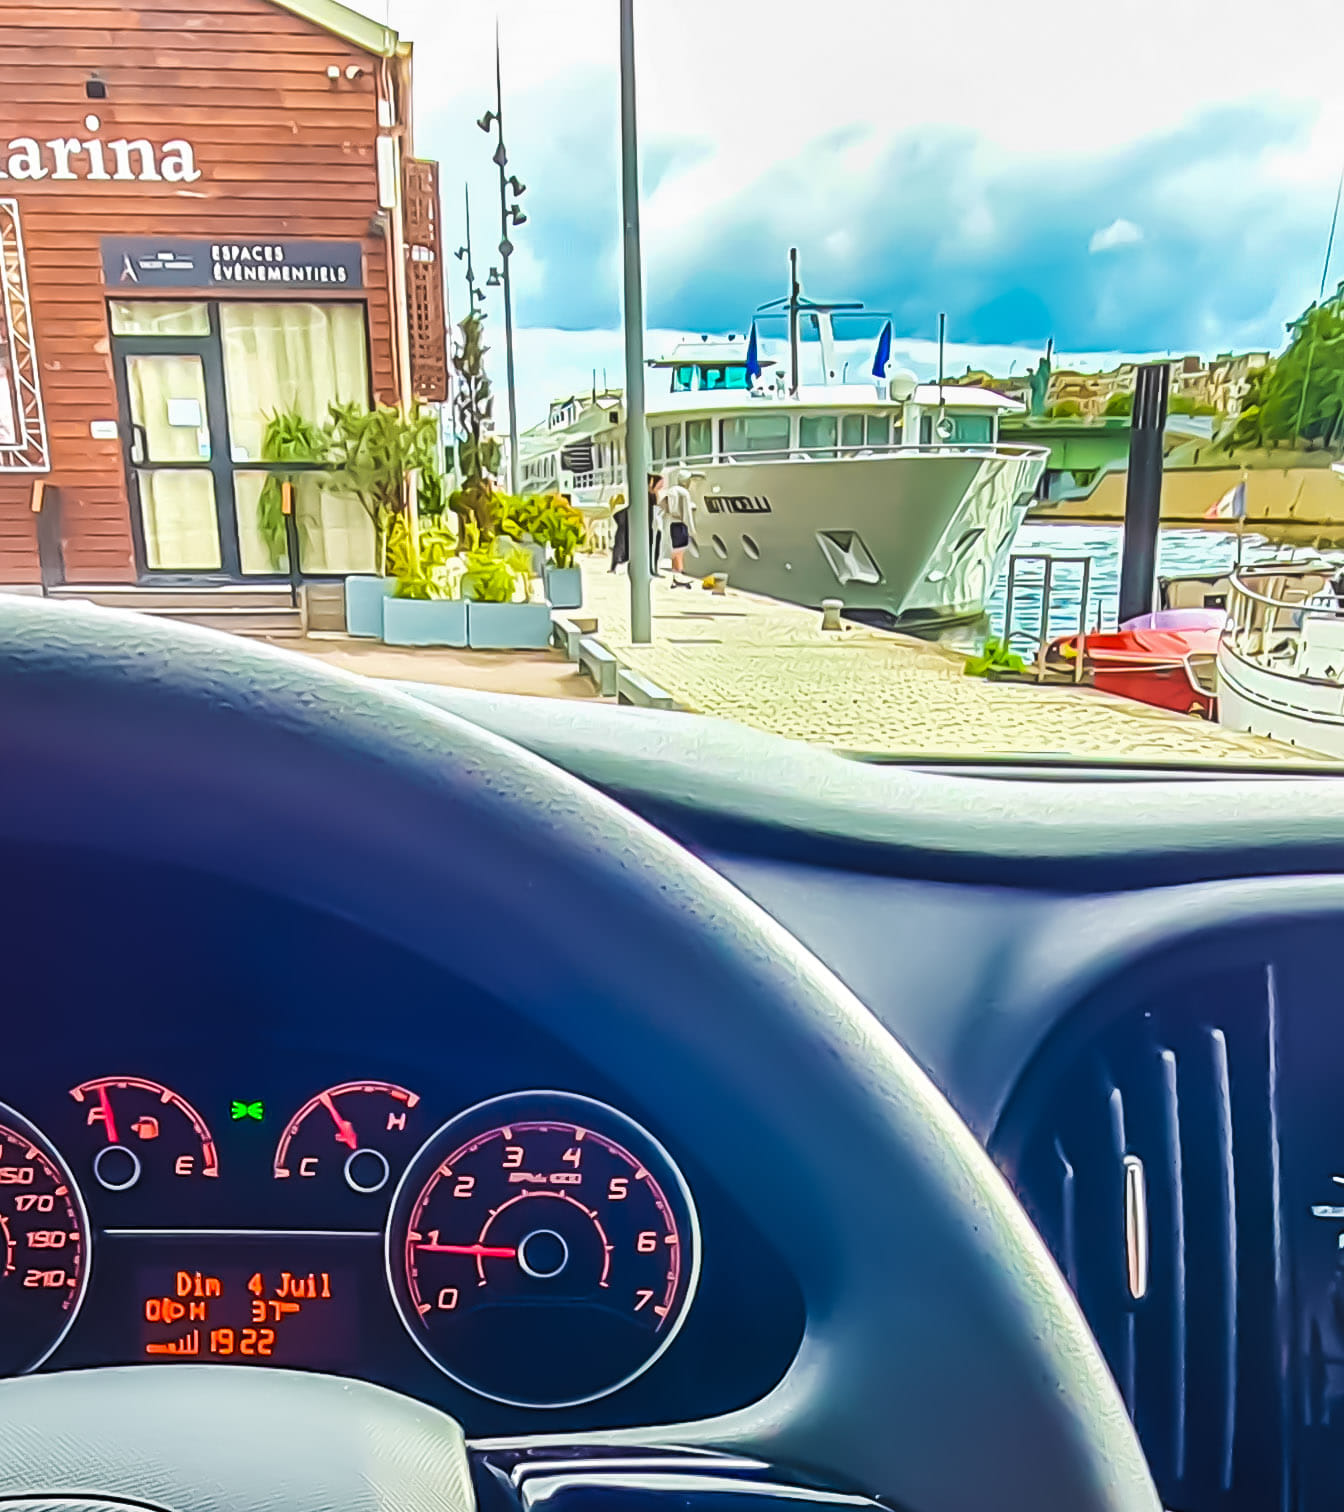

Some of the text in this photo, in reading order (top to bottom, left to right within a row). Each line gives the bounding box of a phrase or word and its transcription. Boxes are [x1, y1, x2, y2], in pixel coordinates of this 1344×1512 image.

[211, 245, 284, 262] ESPACES
[386, 1113, 406, 1130] H
[175, 1156, 194, 1175] E
[299, 1157, 319, 1176] C
[502, 1147, 524, 1168] 3
[562, 1148, 582, 1169] 4
[454, 1176, 475, 1198] 2
[608, 1178, 629, 1200] 5
[14, 1194, 54, 1212] 170
[27, 1231, 67, 1248] 190
[427, 1230, 440, 1246] 1
[637, 1231, 657, 1252] 6
[23, 1269, 65, 1288] 210
[176, 1271, 222, 1297] Dim
[247, 1272, 262, 1296] 4
[438, 1288, 458, 1309] 0
[634, 1290, 654, 1312] 7
